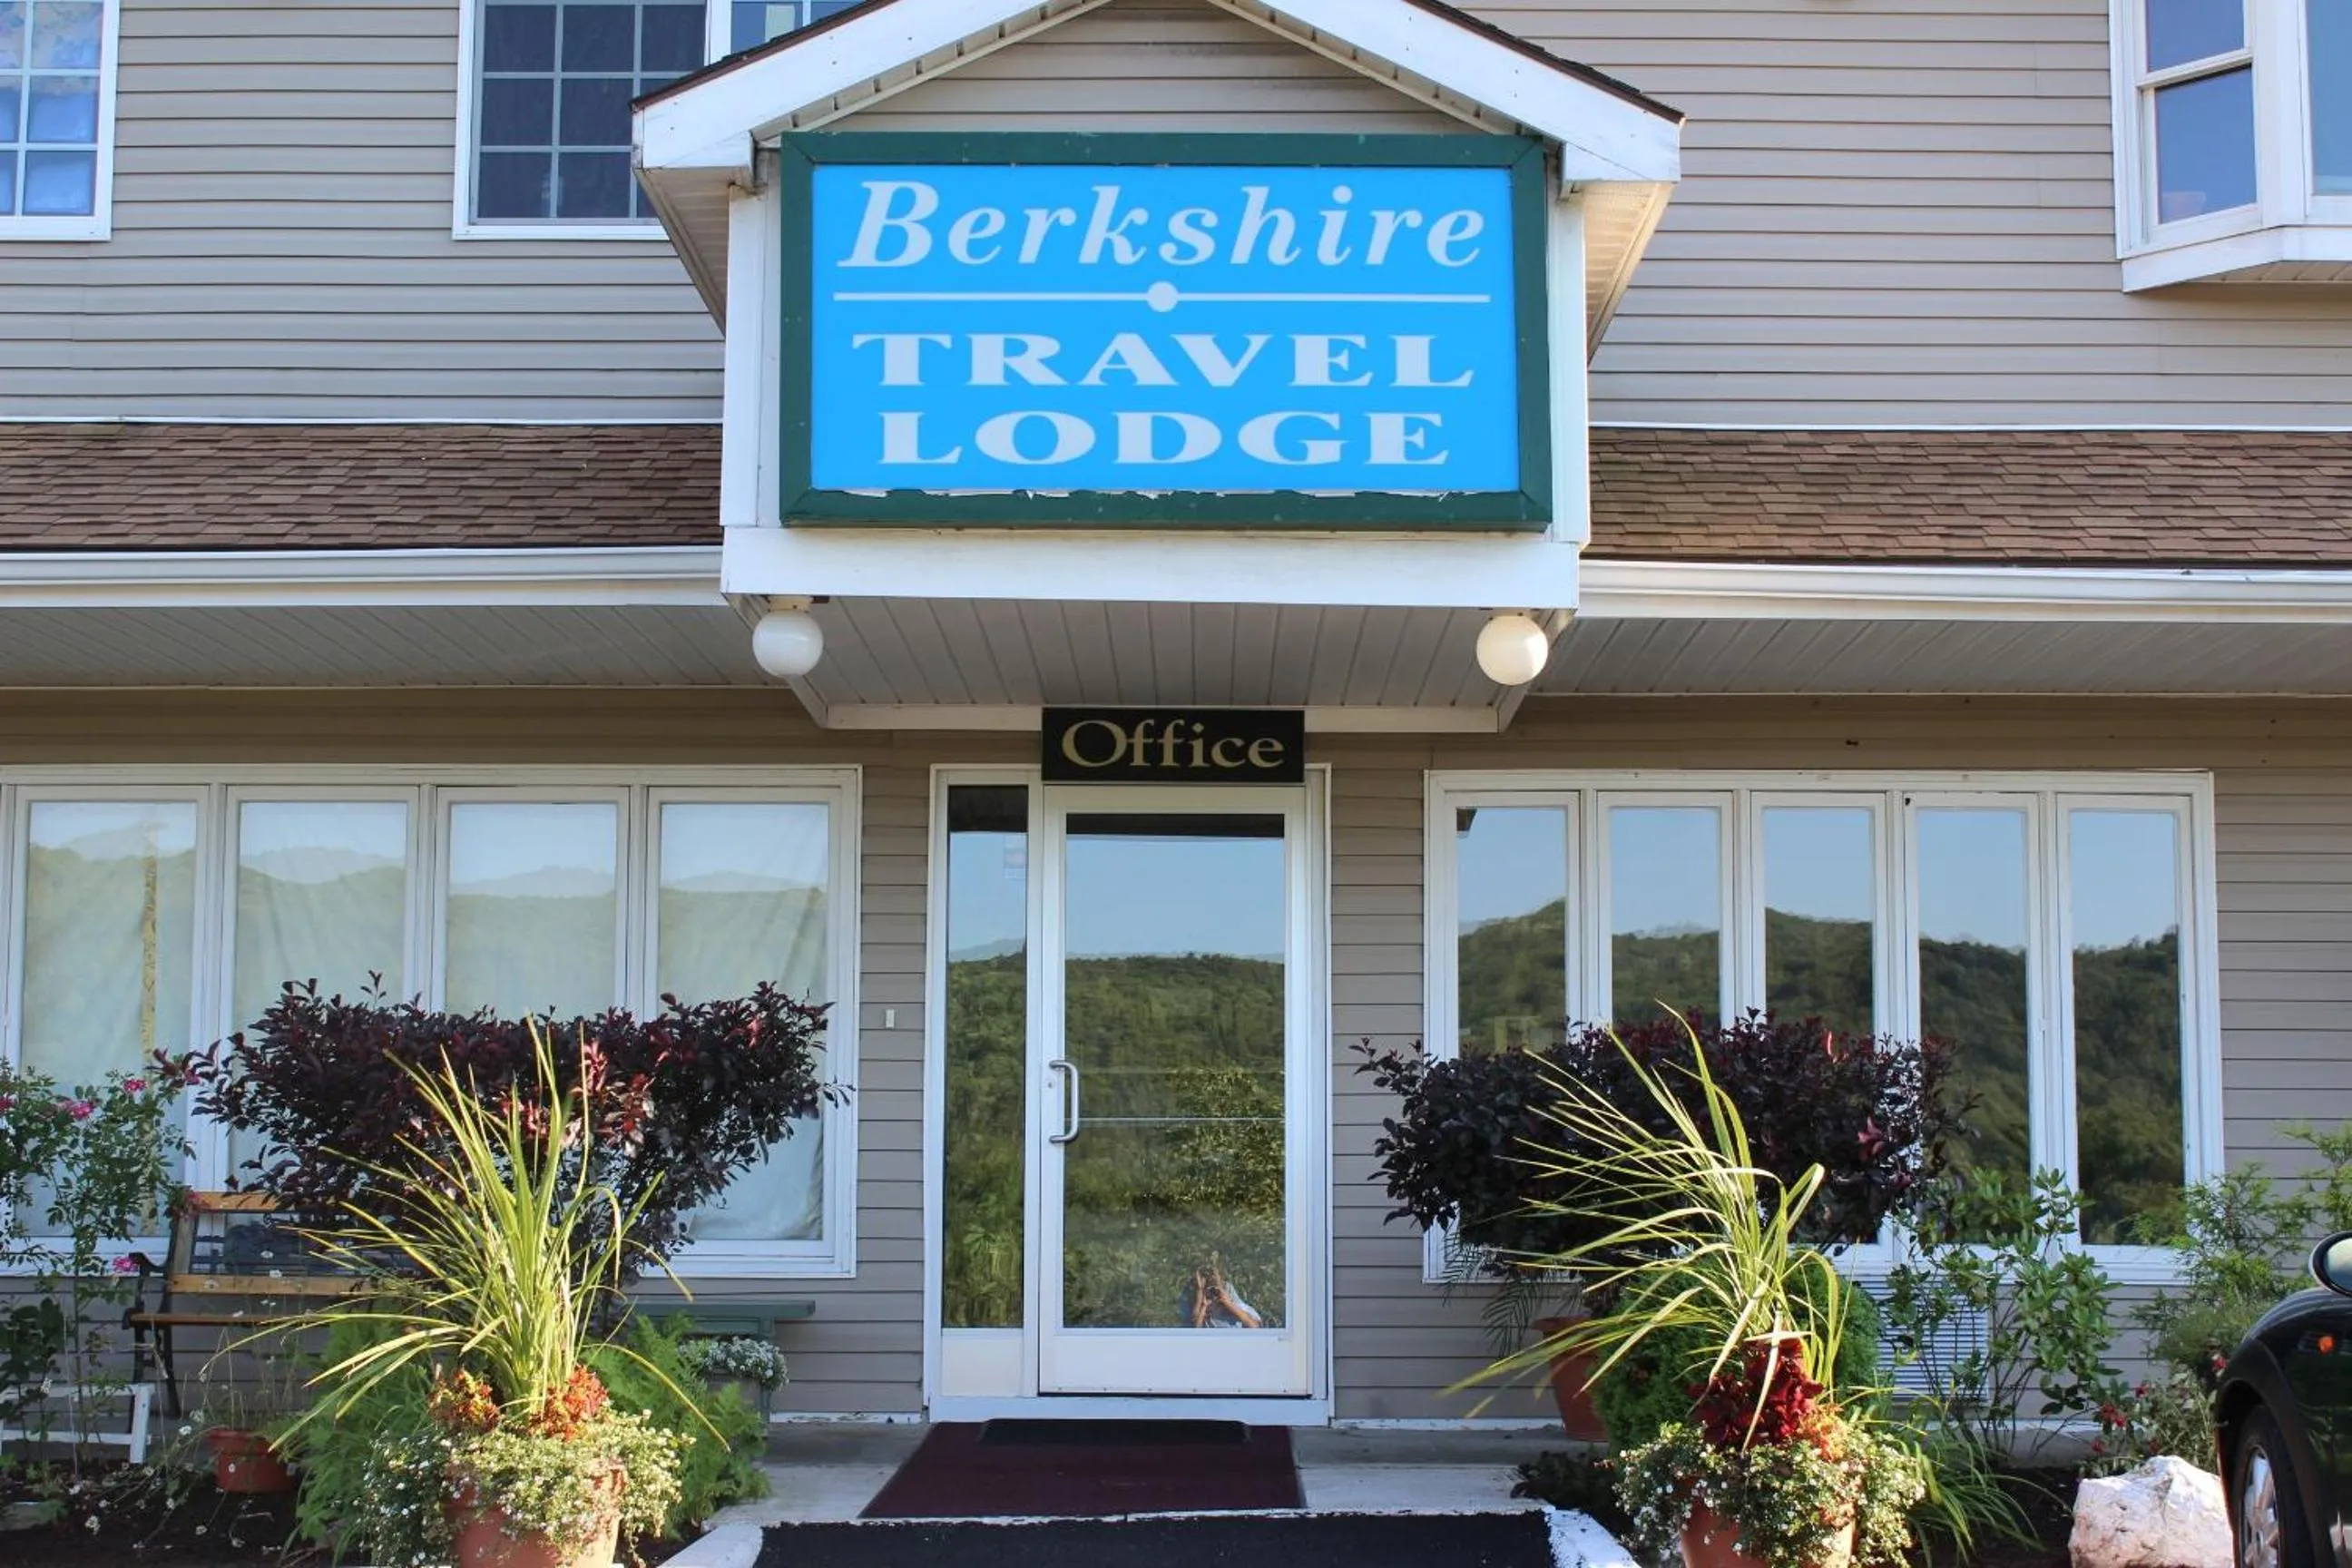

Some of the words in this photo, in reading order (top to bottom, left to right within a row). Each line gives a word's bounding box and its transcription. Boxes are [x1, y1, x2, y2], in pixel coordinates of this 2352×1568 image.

[836, 181, 1485, 268] Berkshire
[852, 332, 1475, 388] TRAVEL
[877, 410, 1450, 466] LODGE
[1062, 719, 1285, 768] Office
